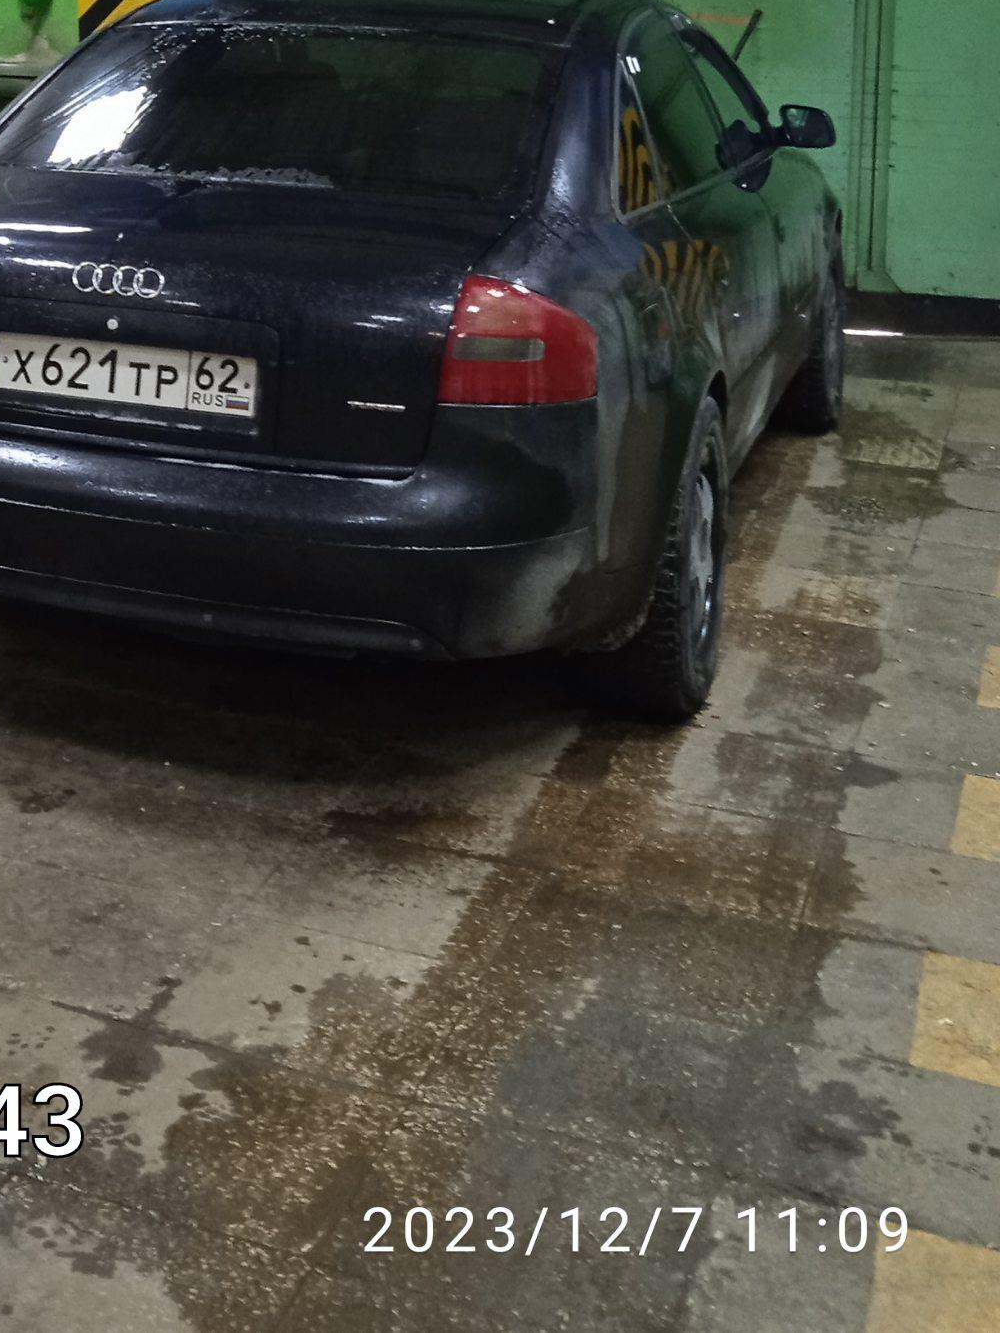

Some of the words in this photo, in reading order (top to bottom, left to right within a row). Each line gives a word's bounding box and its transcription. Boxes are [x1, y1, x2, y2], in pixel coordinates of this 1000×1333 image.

[11, 343, 178, 399] Х621ТР
[195, 356, 240, 394] 62
[191, 393, 224, 407] RUS
